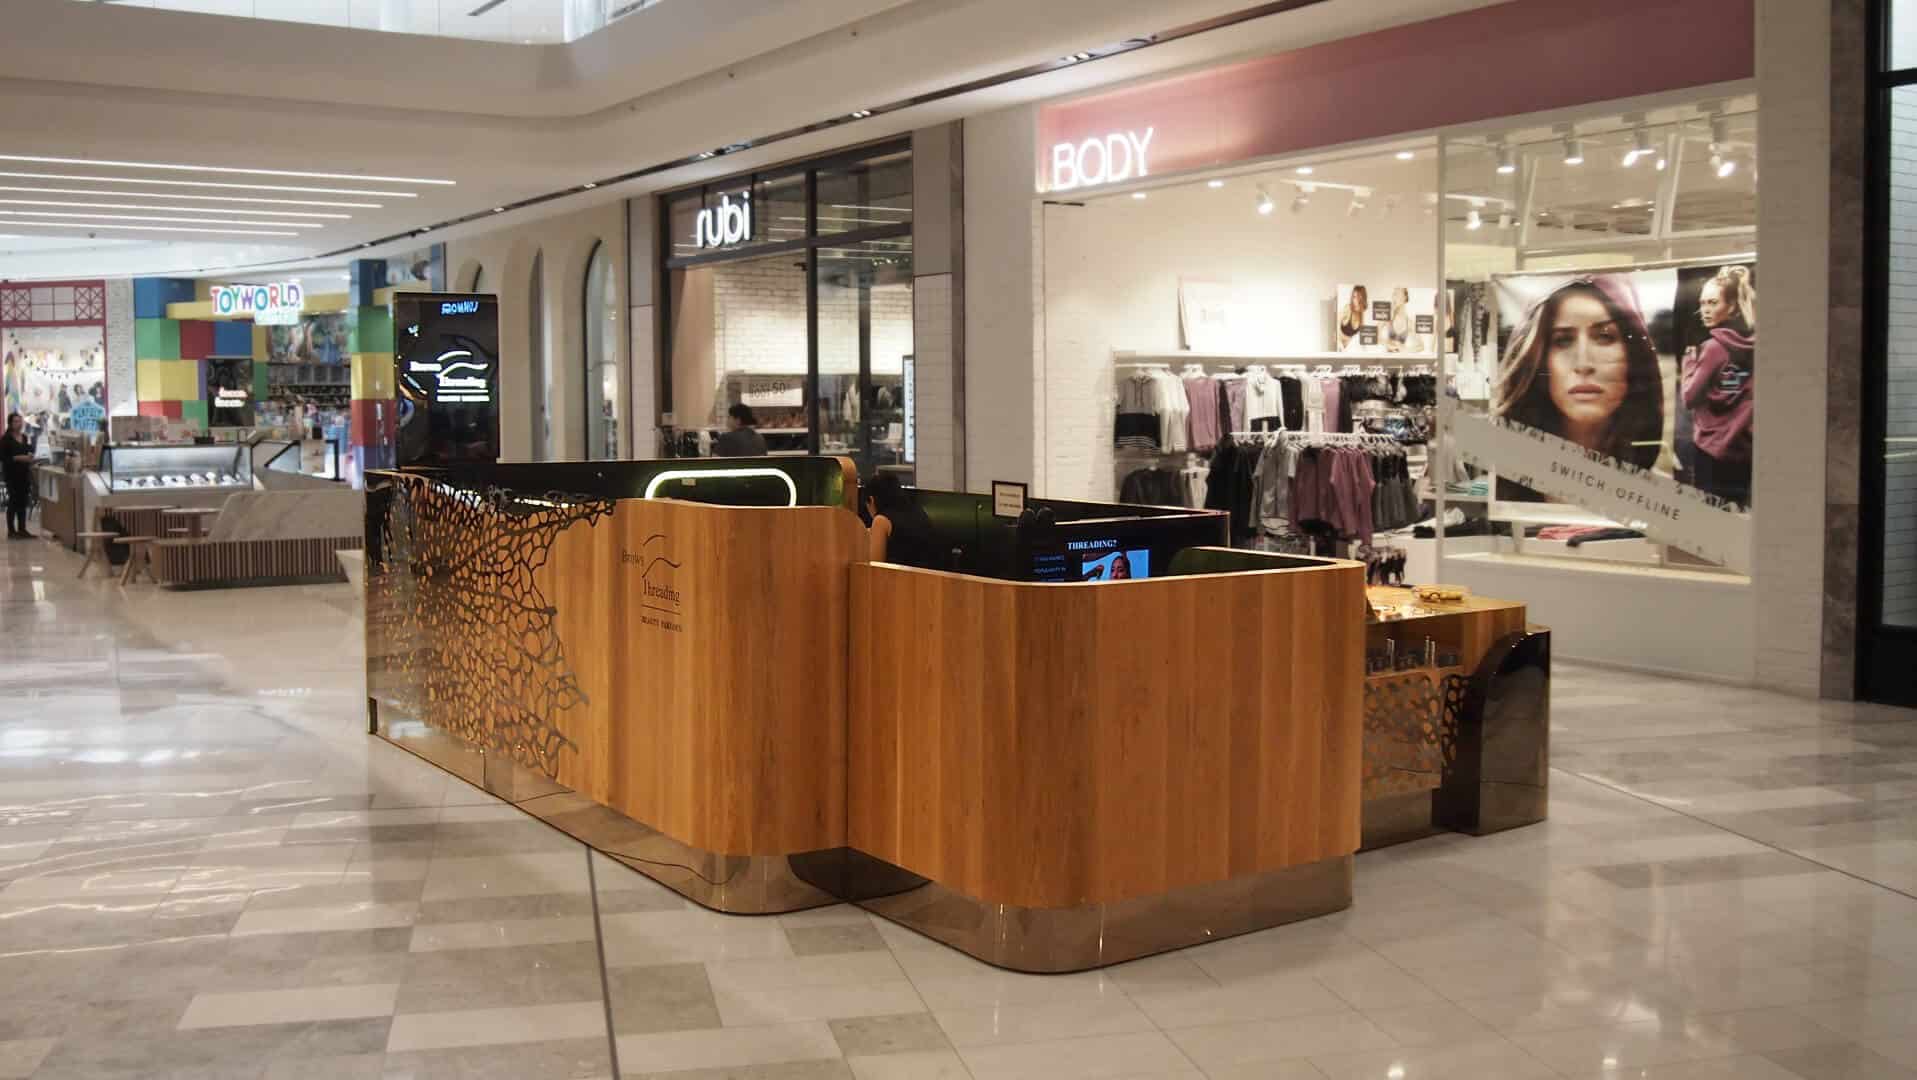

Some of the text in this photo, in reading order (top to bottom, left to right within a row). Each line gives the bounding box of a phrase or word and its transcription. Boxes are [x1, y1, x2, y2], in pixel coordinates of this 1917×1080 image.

[1053, 127, 1153, 191] BODY
[696, 191, 750, 248] rubi
[211, 284, 300, 313] TOYWORLD
[1551, 461, 1681, 521] SWITCH OFFLINE
[1067, 540, 1118, 550] THREADING?
